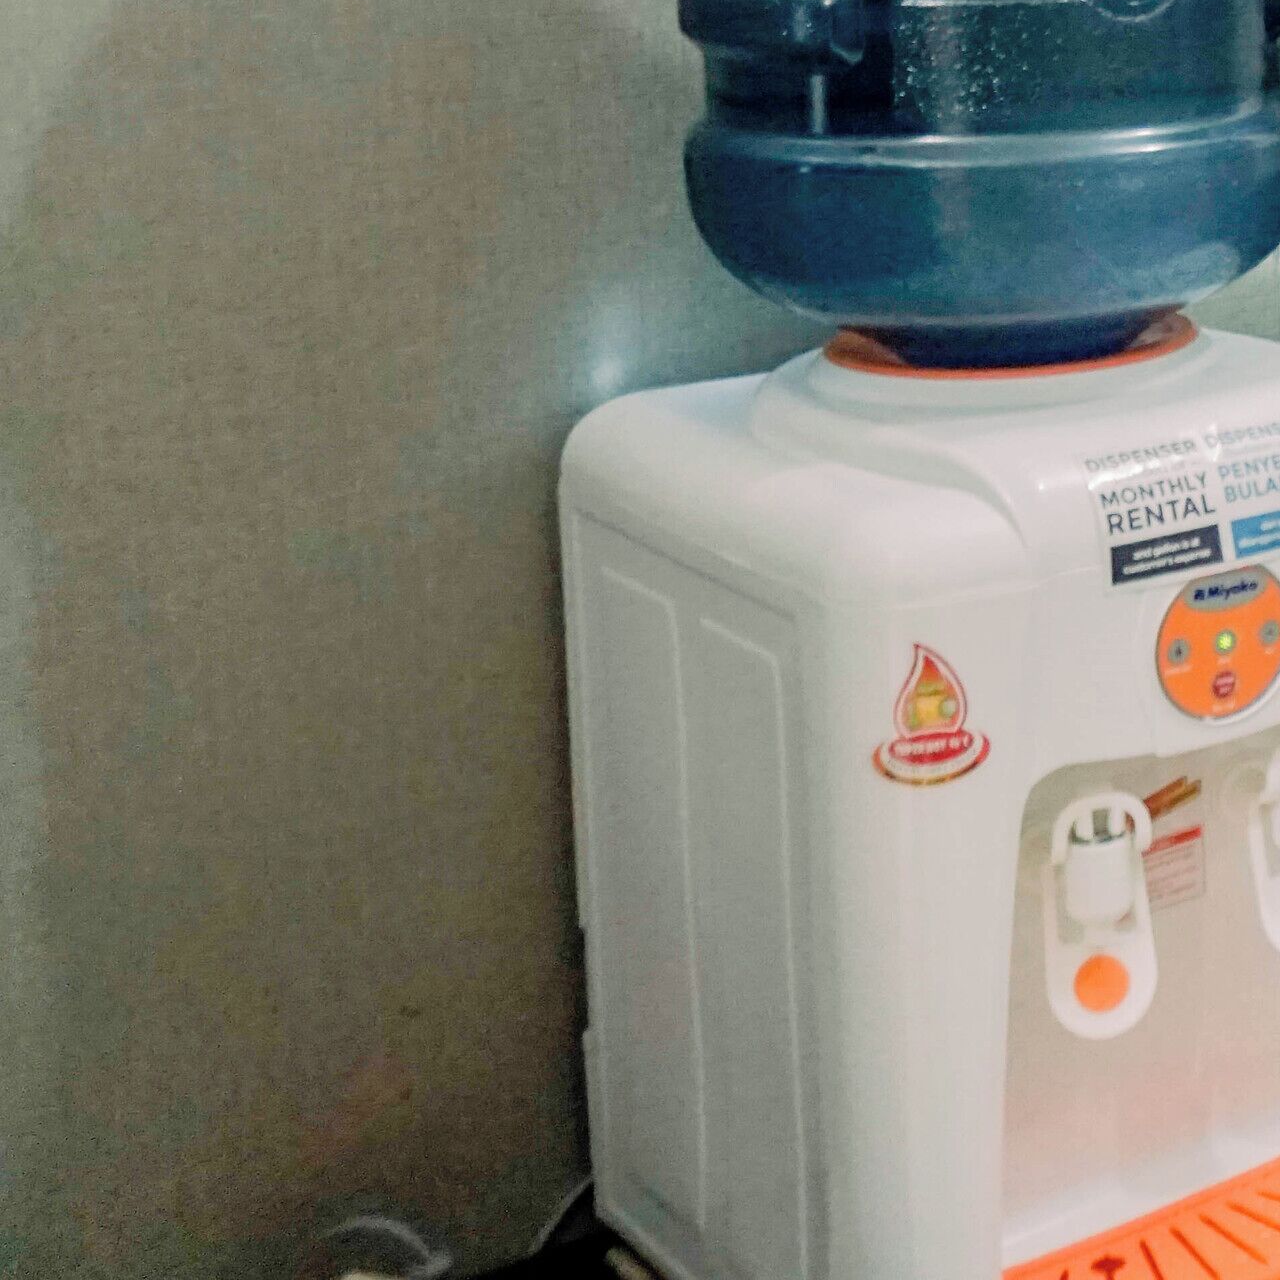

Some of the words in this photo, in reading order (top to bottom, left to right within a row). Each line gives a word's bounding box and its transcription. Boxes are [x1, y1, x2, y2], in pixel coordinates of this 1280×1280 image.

[1084, 439, 1197, 473] DISPENSER
[1100, 472, 1207, 509] MONTHLY
[1107, 494, 1216, 535] RENTAL
[1208, 580, 1258, 600] Miyako
